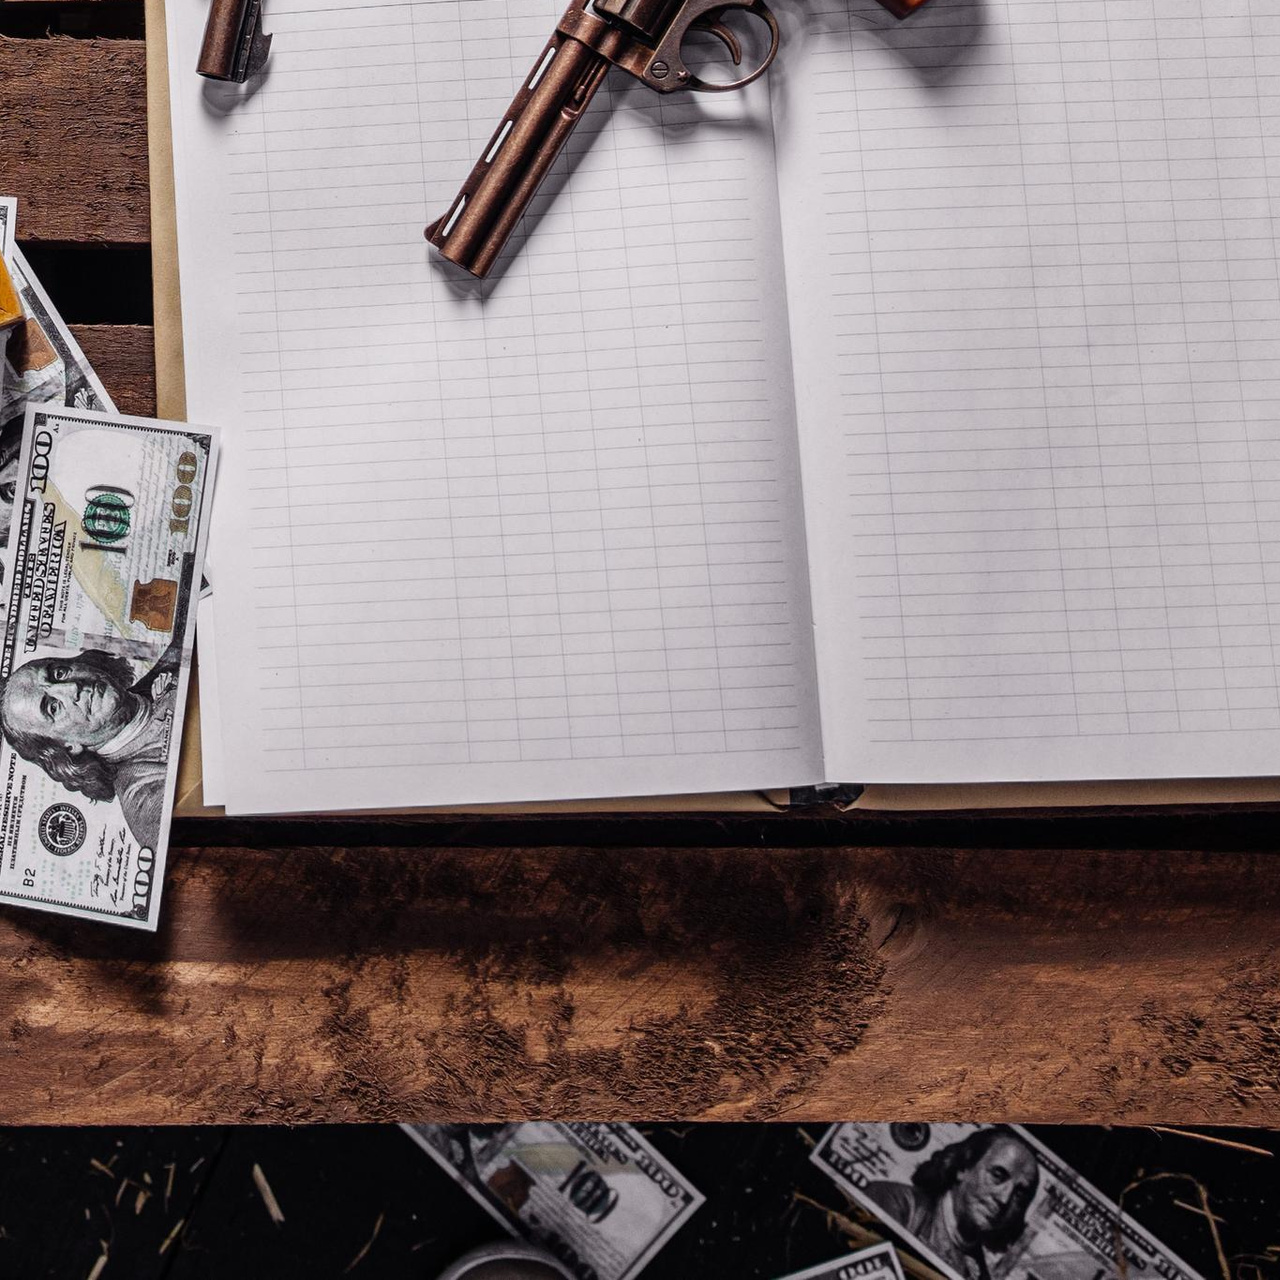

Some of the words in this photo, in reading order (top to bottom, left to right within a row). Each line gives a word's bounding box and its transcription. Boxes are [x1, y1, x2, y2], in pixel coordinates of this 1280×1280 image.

[28, 429, 52, 493] 100
[167, 449, 198, 537] 100
[33, 500, 56, 578] STATES
[23, 576, 46, 654] UNITED
[6, 751, 17, 782] NOTE
[0, 782, 13, 832] RESERVE
[22, 866, 36, 887] B2
[130, 844, 155, 910] 100
